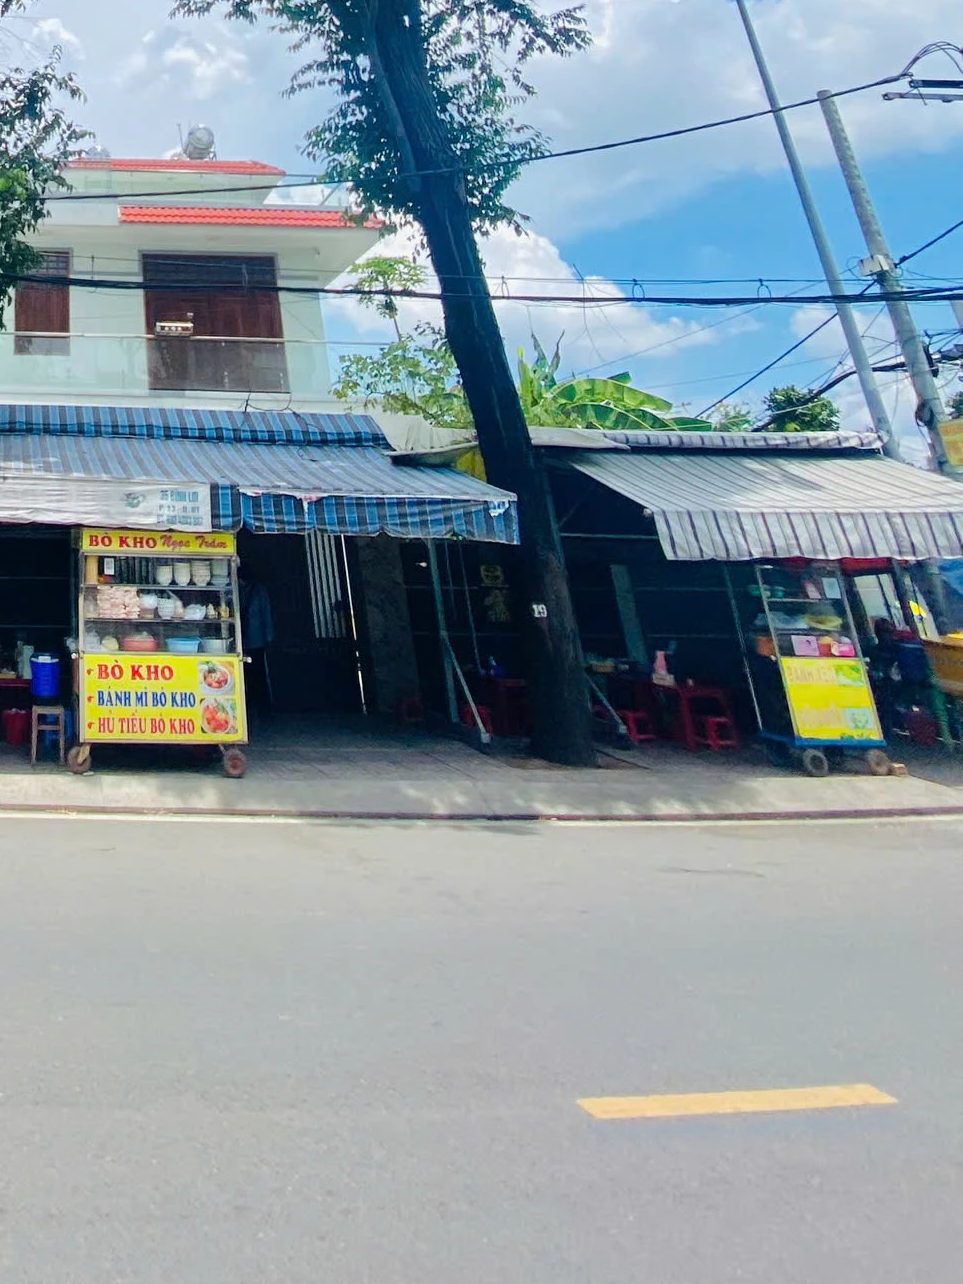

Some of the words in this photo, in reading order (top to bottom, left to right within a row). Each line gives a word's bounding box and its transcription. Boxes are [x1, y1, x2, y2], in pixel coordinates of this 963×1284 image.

[89, 532, 112, 547] BÒ
[119, 535, 158, 549] KHO
[532, 604, 547, 618] 19
[97, 660, 124, 681] BÒ
[131, 664, 174, 681] KHO
[97, 685, 131, 707] BÁNH
[136, 686, 148, 707] MÌ
[152, 686, 167, 707] BÒ
[171, 691, 196, 708] KHO
[150, 713, 166, 734] BÒ
[169, 718, 195, 734] KHO
